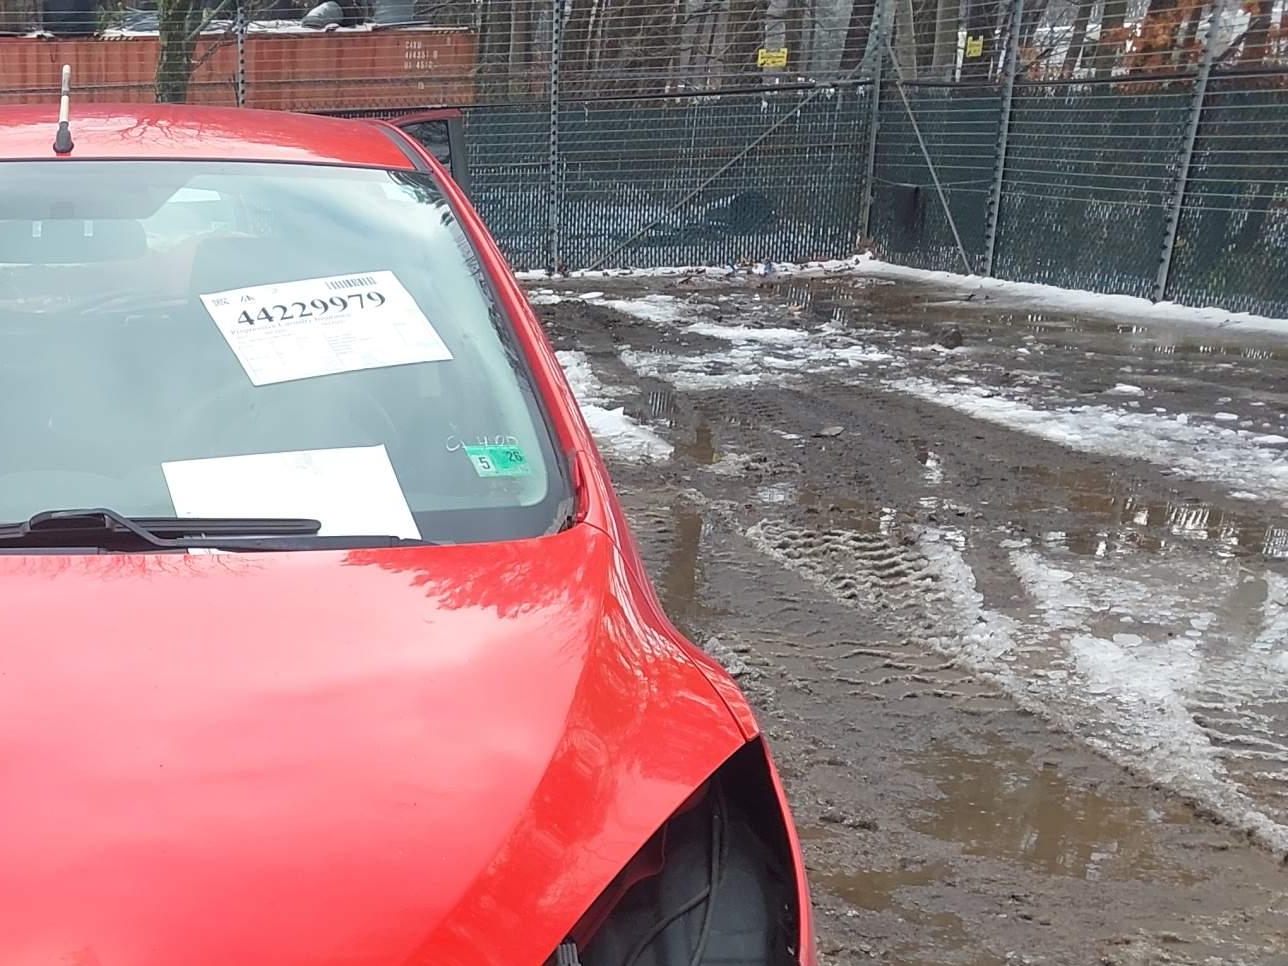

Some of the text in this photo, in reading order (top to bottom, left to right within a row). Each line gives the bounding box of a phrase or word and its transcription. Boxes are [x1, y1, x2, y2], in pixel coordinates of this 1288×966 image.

[237, 290, 387, 326] 44229979
[478, 451, 523, 470] 5 26
